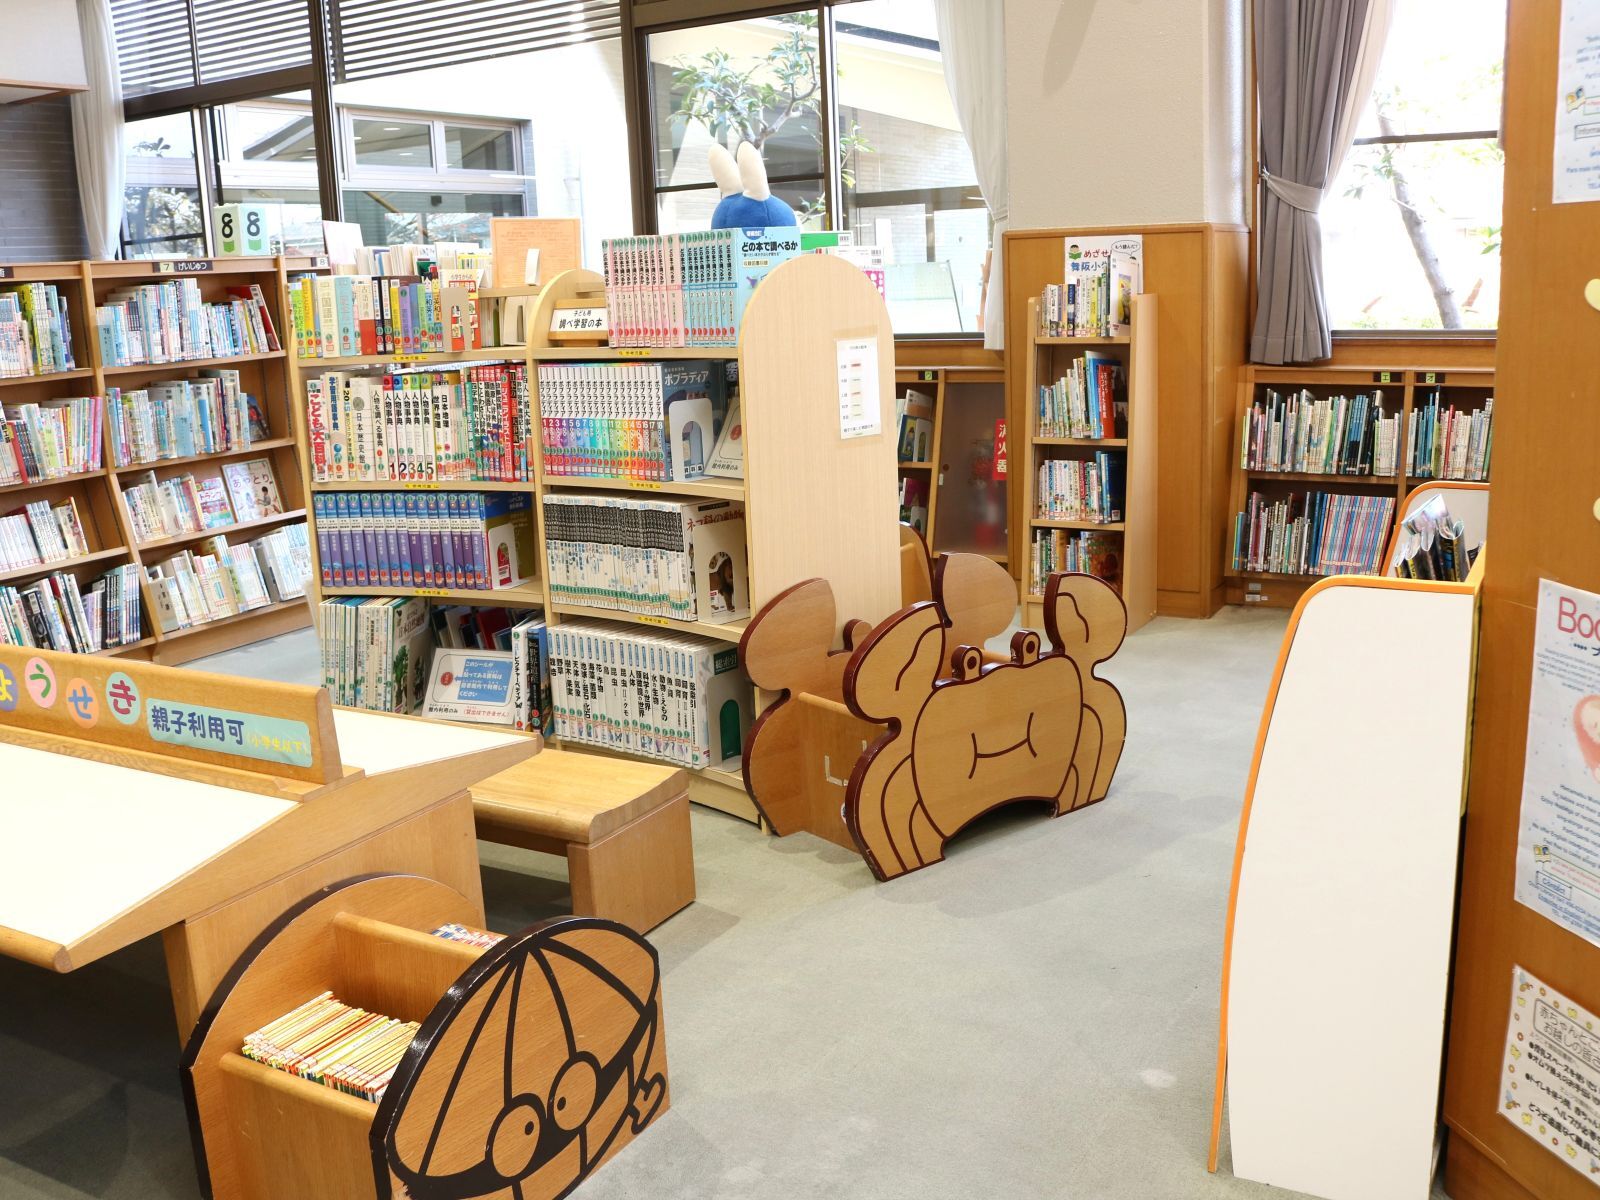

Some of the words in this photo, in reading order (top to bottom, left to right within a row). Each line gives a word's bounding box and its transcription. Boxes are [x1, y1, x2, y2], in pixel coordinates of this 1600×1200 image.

[741, 241, 798, 252] どの本で調べるか
[558, 317, 603, 329] 調べ学習の本
[664, 370, 709, 386] ポプラディア
[373, 390, 384, 447] 人物を調べる事典
[384, 392, 394, 425] 人物事典
[394, 392, 404, 425] 人物事典
[403, 392, 412, 425] 人物事典
[412, 392, 420, 425] 人物事典
[422, 391, 431, 425] 人物事典
[432, 396, 441, 428] 世界地理
[441, 394, 450, 428] 日本地理
[389, 462, 396, 473] 1
[399, 462, 407, 473] 2
[408, 462, 416, 473] 3
[416, 462, 425, 473] 4
[426, 462, 435, 473] 5
[629, 669, 636, 687] 人体
[642, 672, 651, 711] 科学の世界
[651, 673, 659, 705] 水の生物
[151, 704, 245, 746] 親子利用可
[428, 706, 459, 714] 館内利用のみ
